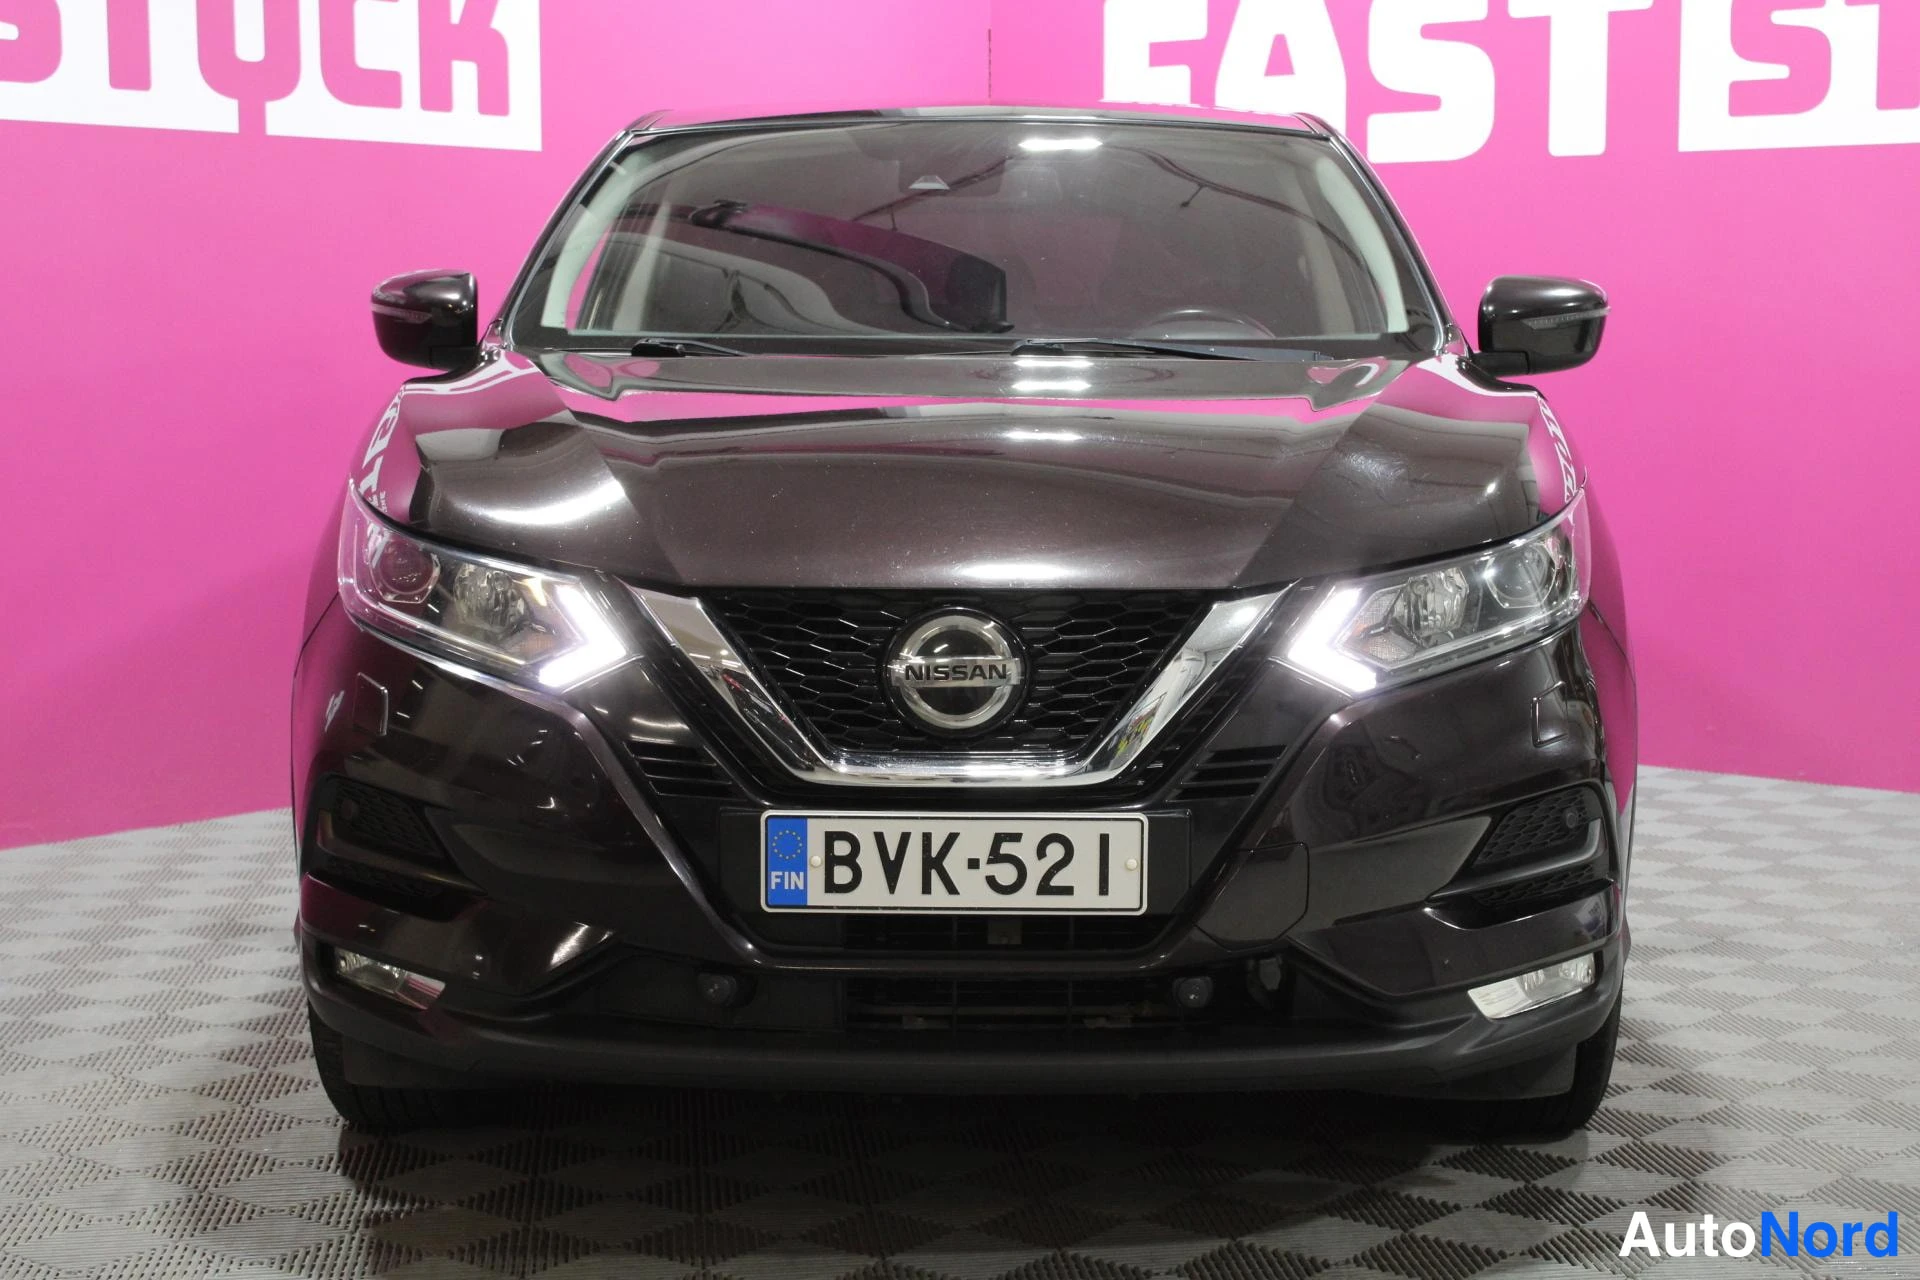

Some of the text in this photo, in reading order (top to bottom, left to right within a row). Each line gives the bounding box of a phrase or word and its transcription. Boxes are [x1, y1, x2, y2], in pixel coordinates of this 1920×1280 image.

[905, 664, 1007, 681] NISSAN
[824, 831, 1110, 896] BVK-521
[770, 871, 805, 890] FIN
